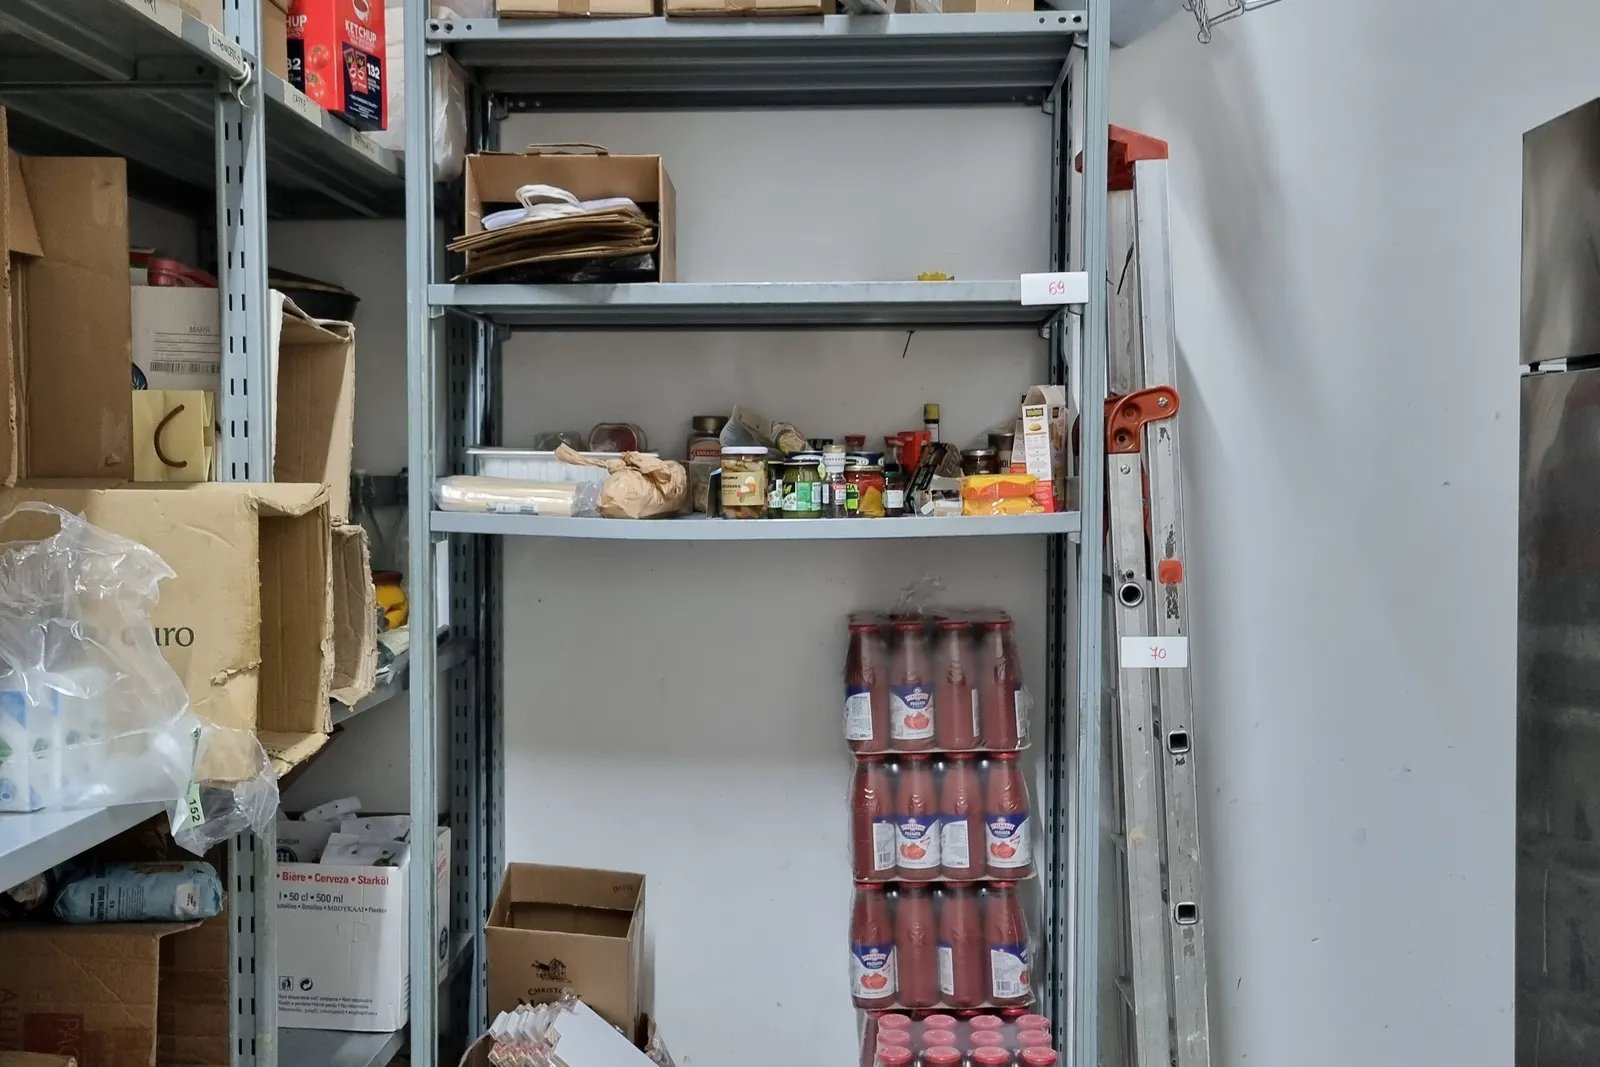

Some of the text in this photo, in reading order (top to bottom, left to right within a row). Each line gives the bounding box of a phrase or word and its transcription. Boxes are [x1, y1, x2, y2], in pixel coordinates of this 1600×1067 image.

[345, 19, 377, 44] KETCHUP
[367, 62, 380, 80] 132
[1048, 280, 1065, 296] 69
[1149, 645, 1167, 661] 70
[188, 798, 201, 823] 152
[282, 871, 389, 886] Bière Cerveza Starköl
[289, 892, 299, 901] 50
[300, 893, 309, 902] cl
[316, 894, 331, 903] 500
[333, 894, 344, 903] ml
